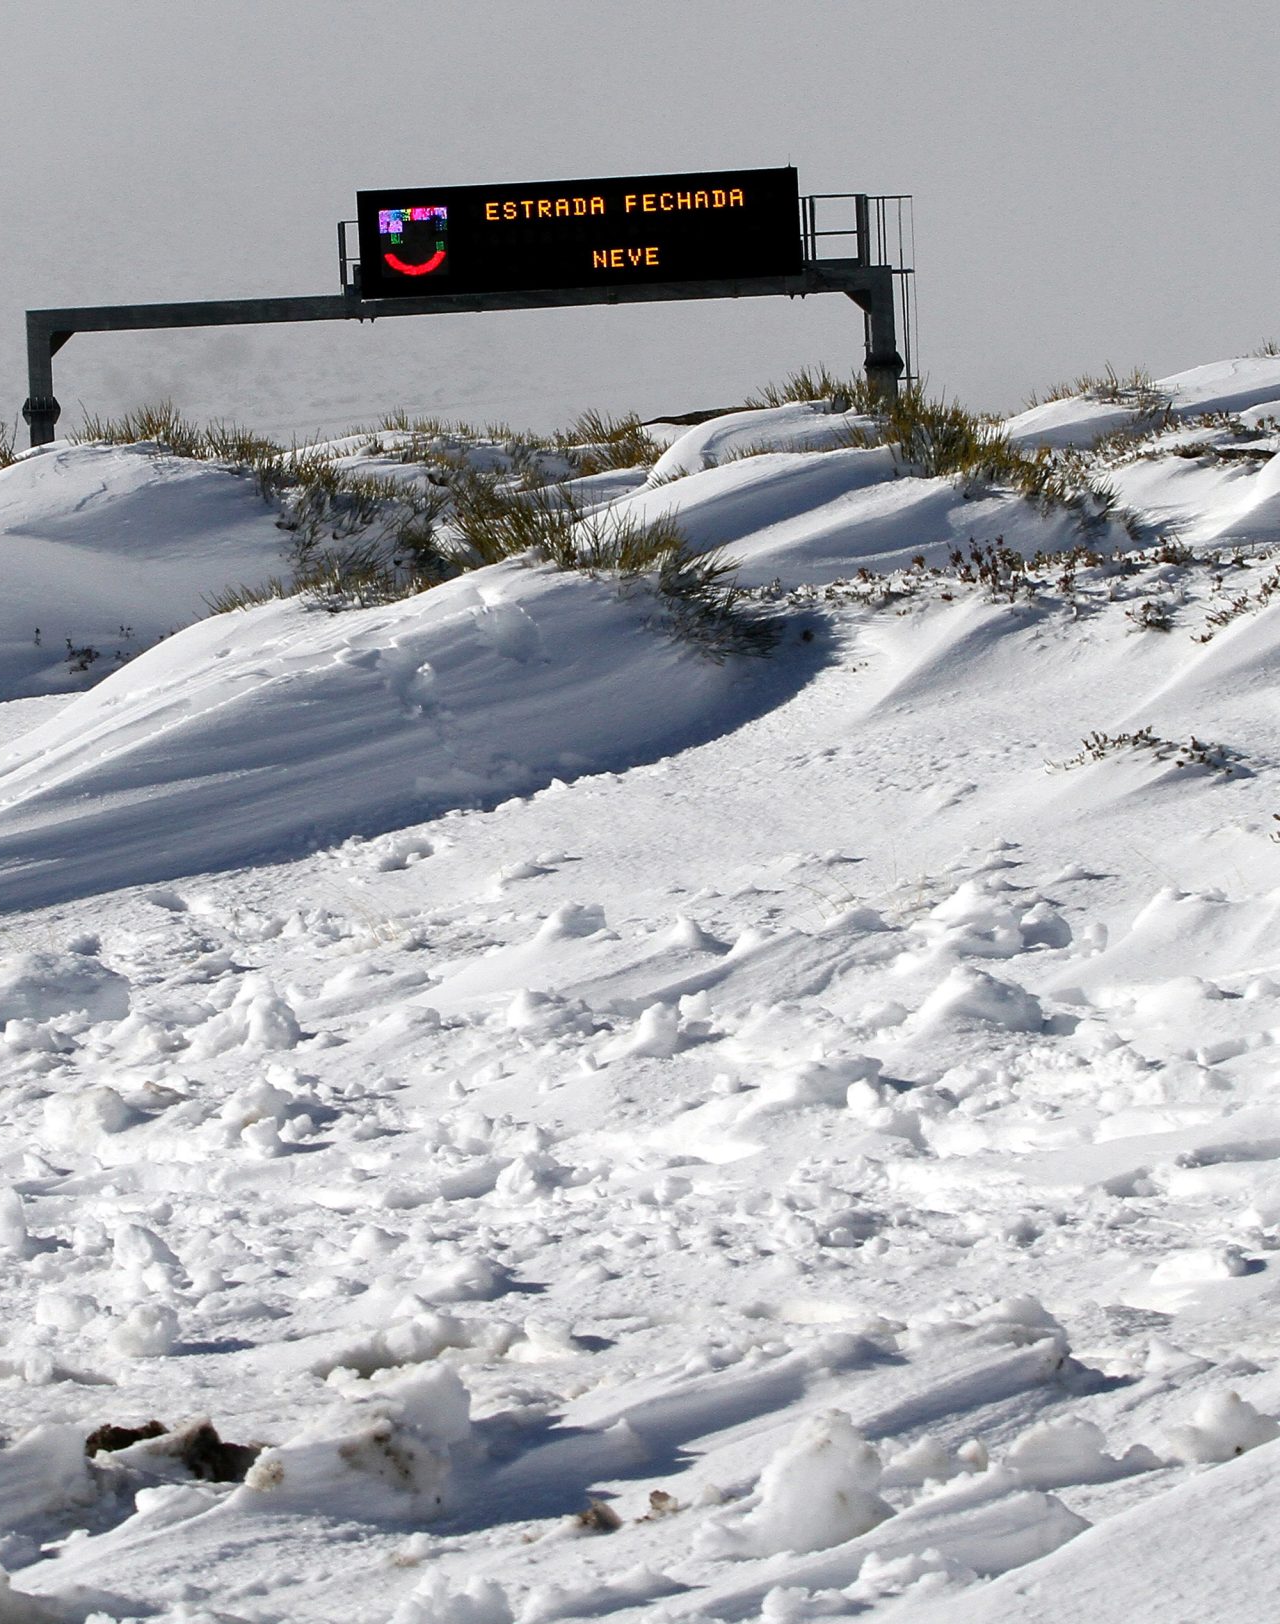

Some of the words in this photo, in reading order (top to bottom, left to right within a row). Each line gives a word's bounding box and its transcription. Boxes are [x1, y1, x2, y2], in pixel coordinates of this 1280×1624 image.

[485, 196, 605, 220] ESTRADA
[624, 188, 745, 213] FECHADA
[592, 248, 660, 269] NEVE
